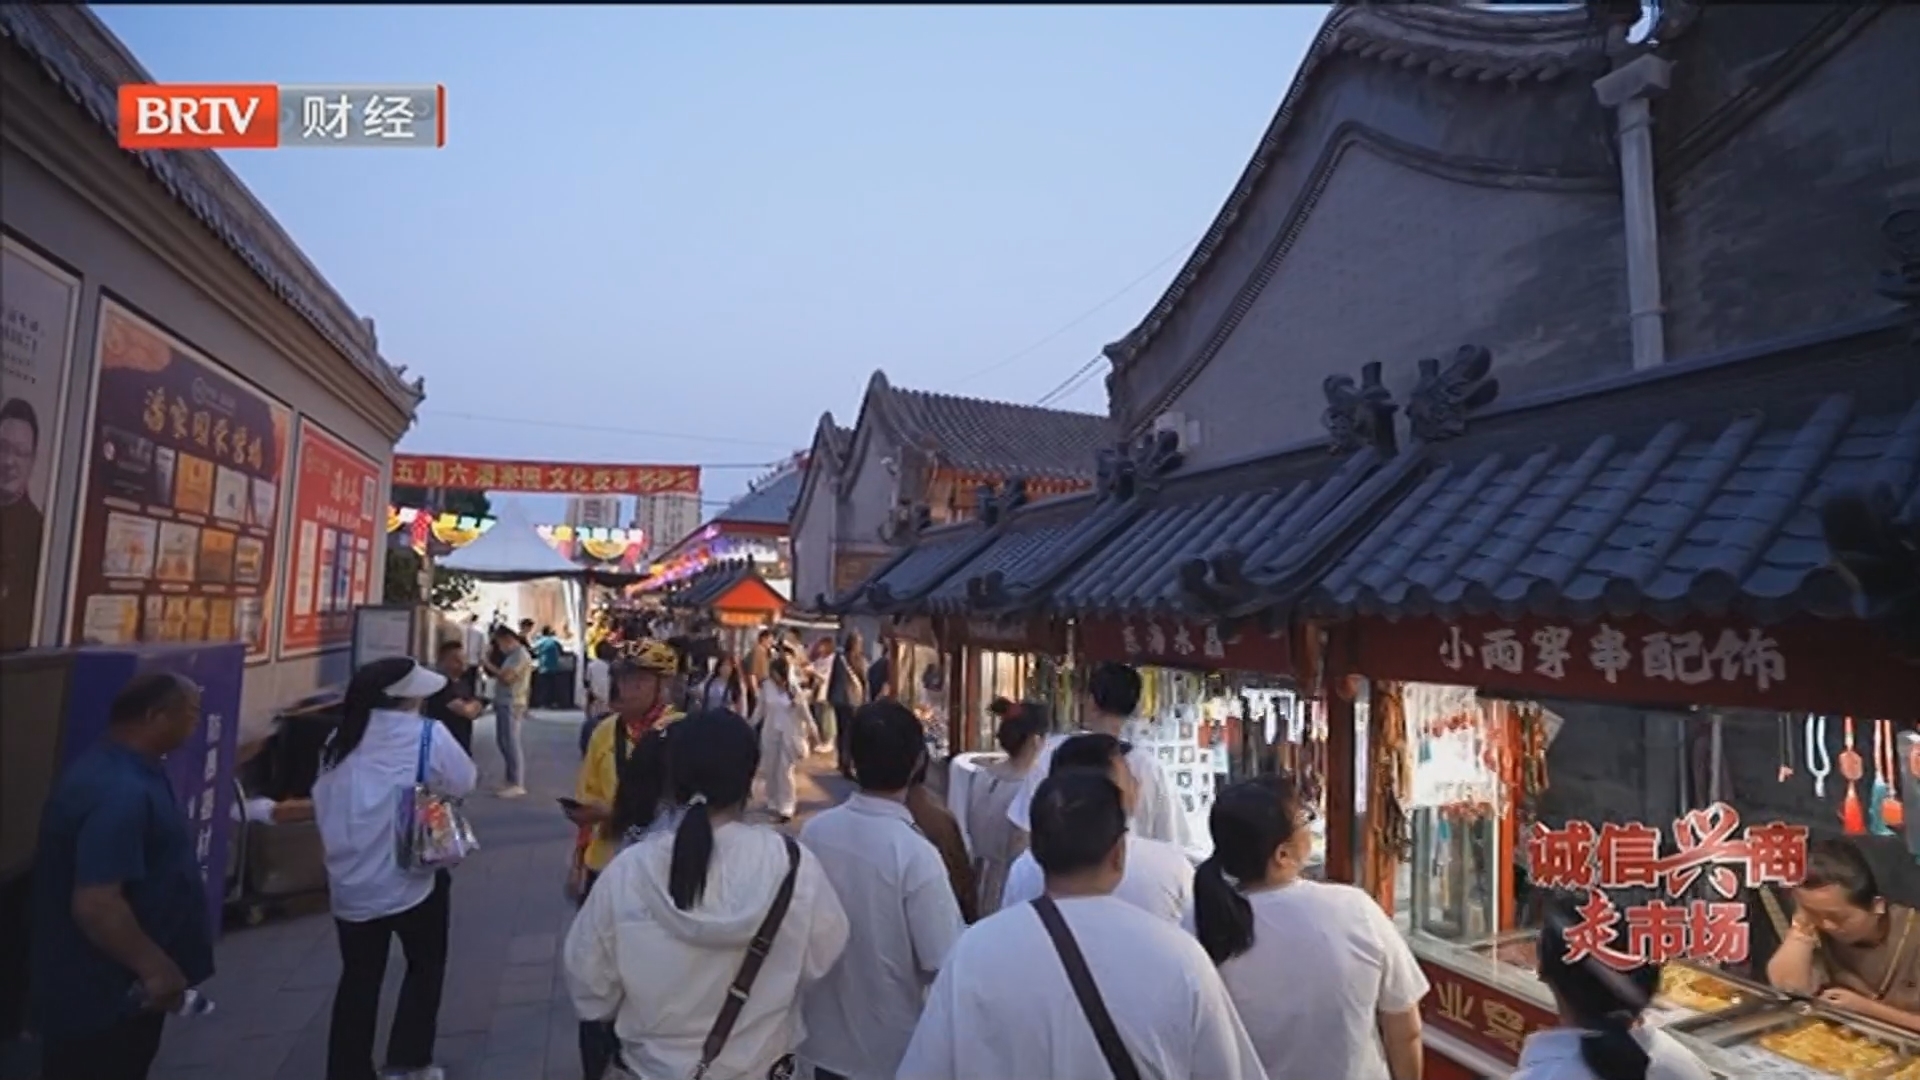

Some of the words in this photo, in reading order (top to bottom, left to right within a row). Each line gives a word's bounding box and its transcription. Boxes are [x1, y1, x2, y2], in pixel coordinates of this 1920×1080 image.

[1439, 624, 1787, 691] 小雨穿串配饰
